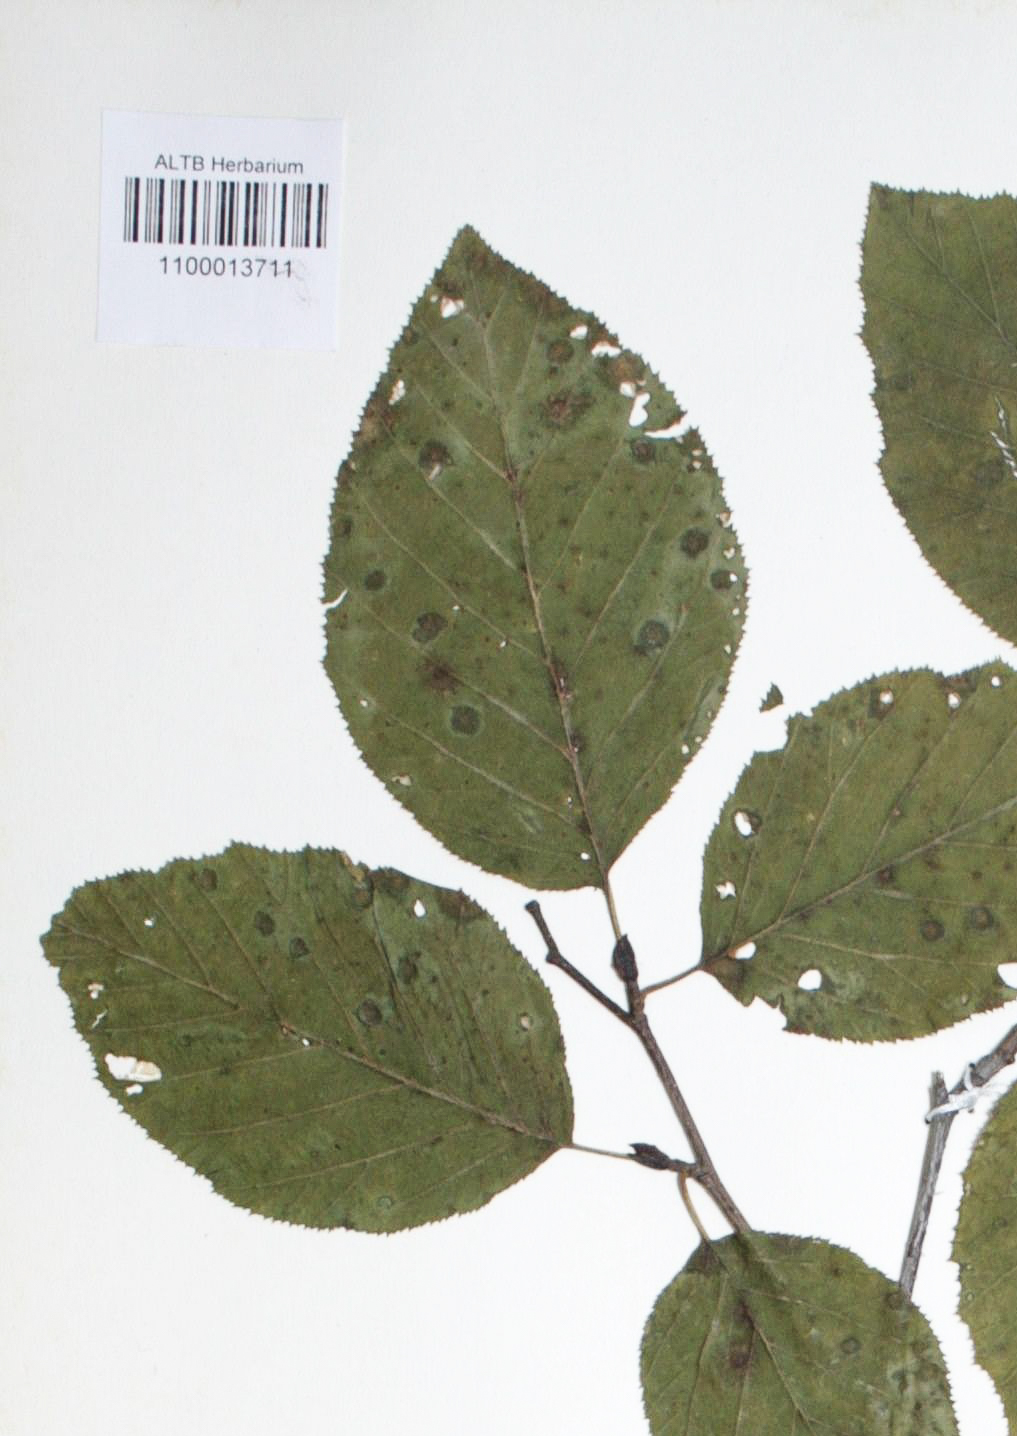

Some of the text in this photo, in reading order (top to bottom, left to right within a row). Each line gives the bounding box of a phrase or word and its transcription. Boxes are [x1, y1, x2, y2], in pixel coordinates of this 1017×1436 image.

[154, 154, 304, 175] ALTB Herbarium
[159, 256, 293, 279] 1100013711
